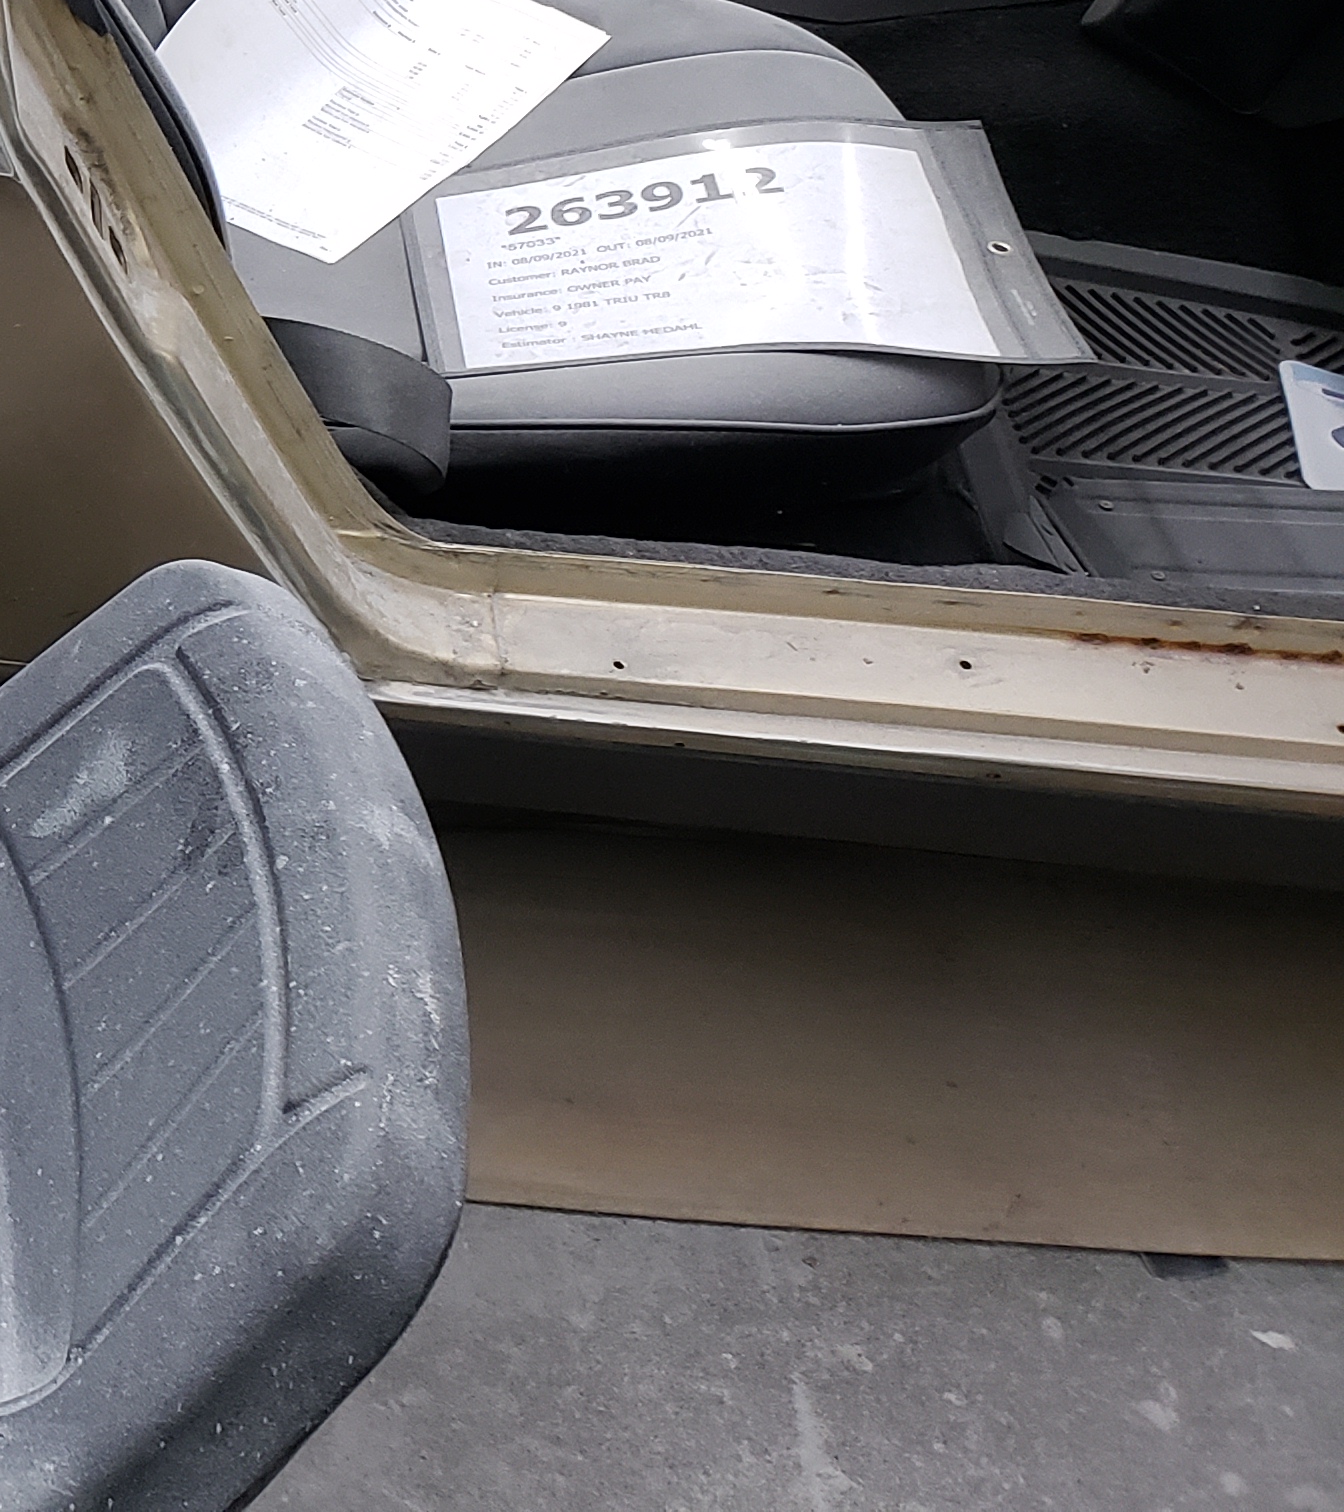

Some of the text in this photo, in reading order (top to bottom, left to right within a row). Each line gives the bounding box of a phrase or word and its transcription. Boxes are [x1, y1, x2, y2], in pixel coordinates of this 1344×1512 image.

[505, 166, 785, 236] 263912
[486, 227, 713, 270] IN: 08/09/2021 OUT: 08/09/2021
[488, 255, 661, 286] Customer: RAYNOR BRAD
[492, 274, 652, 303] Insurance: OWNER PAY
[492, 306, 548, 318] Vehicle:
[567, 300, 599, 310] 1981
[498, 322, 553, 334] License:
[501, 337, 567, 349] Estimator
[580, 329, 638, 342] SHAYNE
